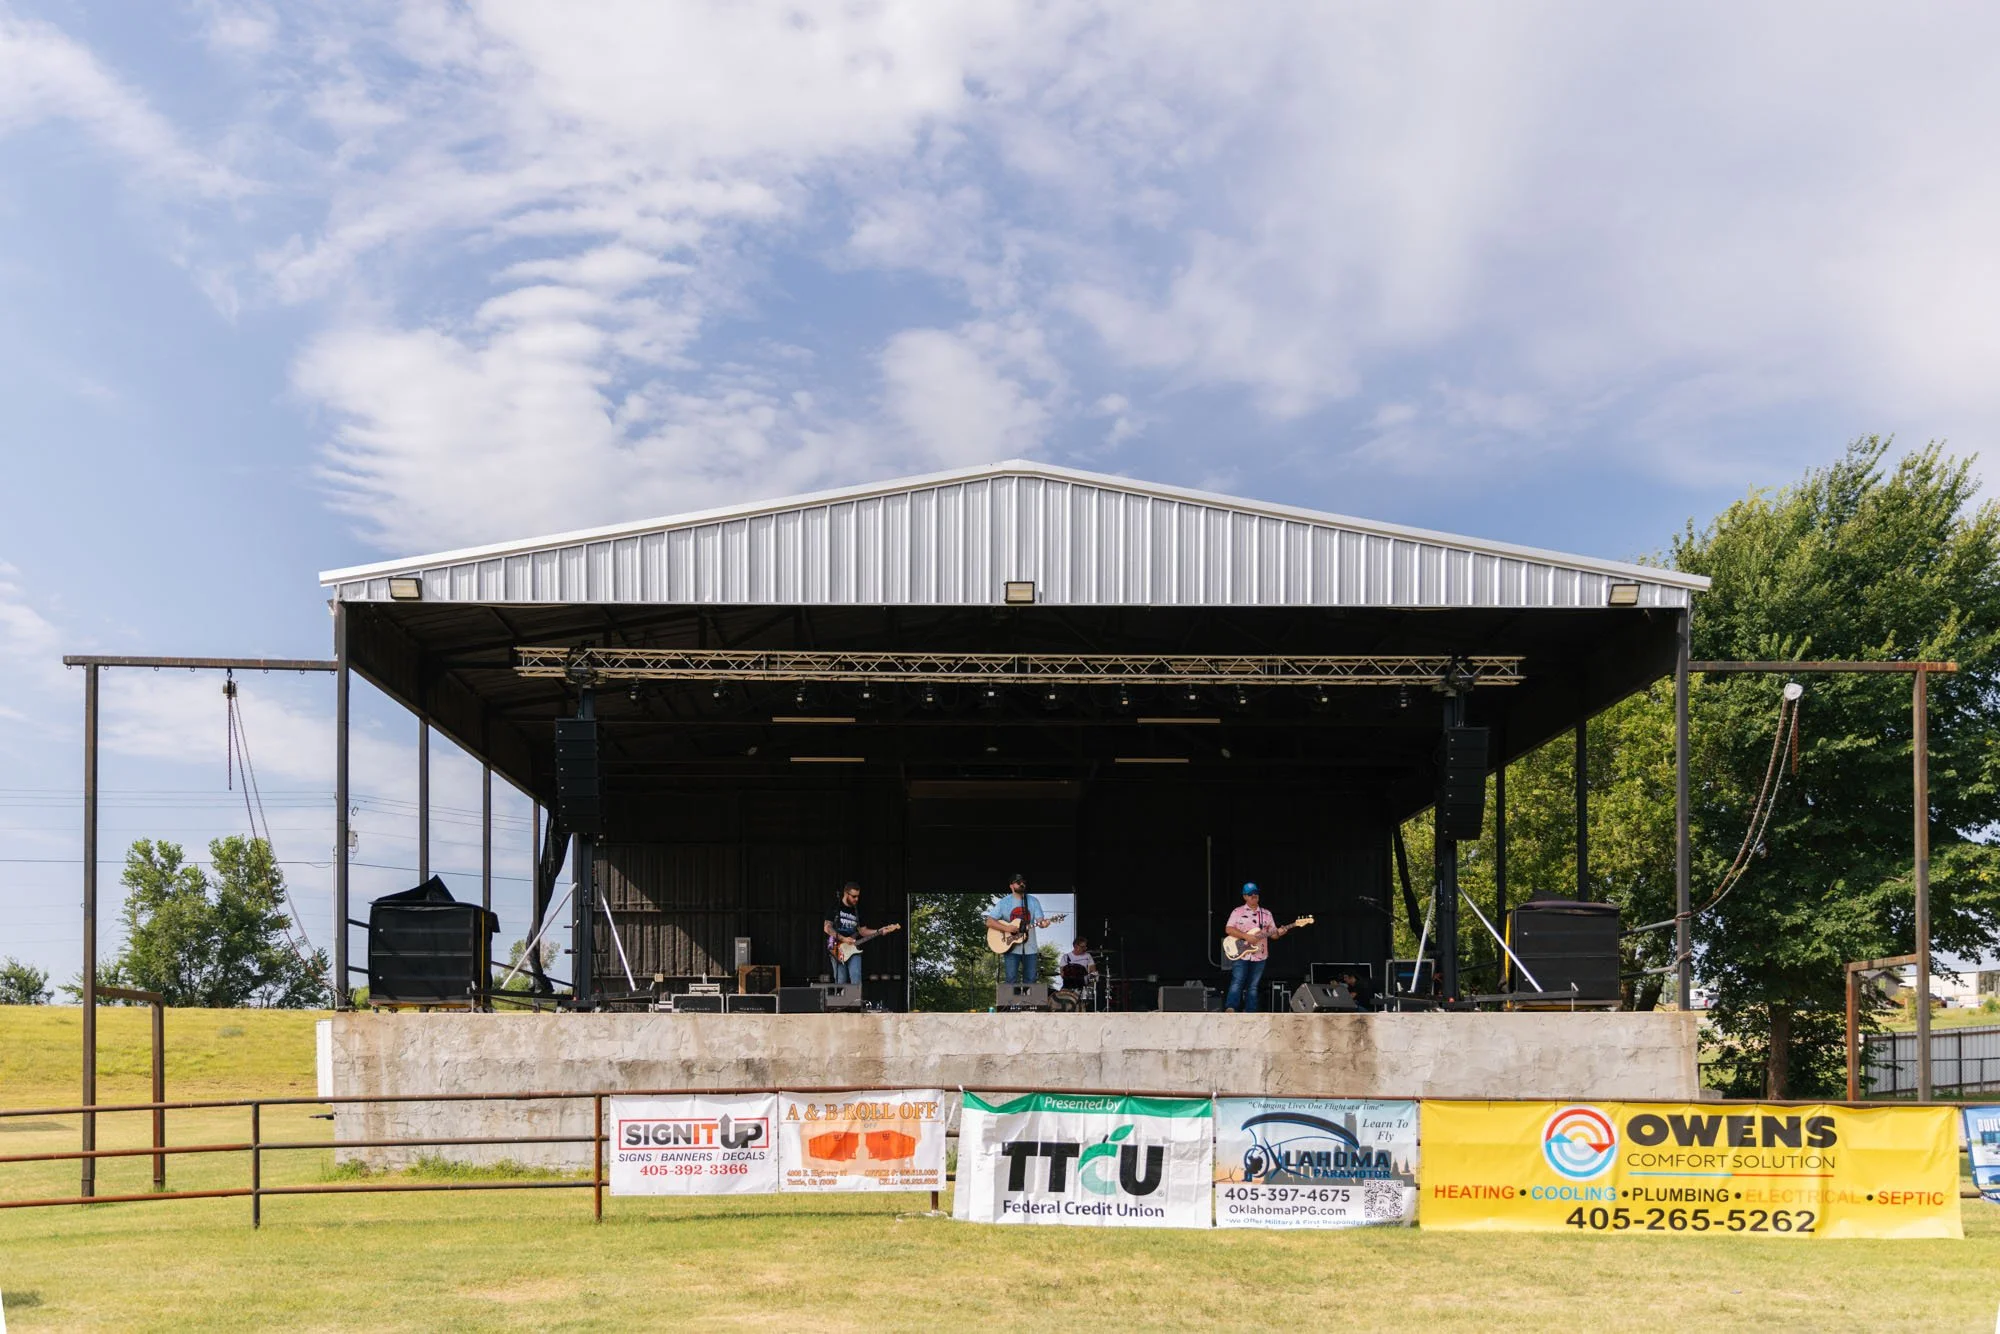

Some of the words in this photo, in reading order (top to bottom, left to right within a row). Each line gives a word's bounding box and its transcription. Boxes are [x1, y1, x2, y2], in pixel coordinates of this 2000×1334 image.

[786, 1103, 800, 1121] A
[804, 1103, 820, 1121] &
[825, 1103, 838, 1121] B
[843, 1102, 896, 1121] ROLL
[899, 1101, 938, 1120] OFF
[1044, 1096, 1104, 1110] Presented
[1106, 1099, 1121, 1112] by
[1288, 1101, 1306, 1110] Lives
[1308, 1103, 1322, 1111] One
[1324, 1103, 1346, 1111] Flight
[1362, 1118, 1394, 1129] Learn
[1396, 1118, 1409, 1129] To
[1978, 1118, 2000, 1132] BUIL
[1377, 1130, 1394, 1143] Fly
[1626, 1113, 1838, 1149] OWENS
[618, 1152, 652, 1163] SIGNS
[661, 1152, 713, 1163] BANNERS
[722, 1151, 766, 1162] DECALS
[1627, 1153, 1729, 1169] COMFORT
[1732, 1155, 1836, 1169] SOLUTION
[639, 1163, 748, 1176] 405-392-3366
[1001, 1140, 1165, 1196] TTCU
[1313, 1168, 1391, 1179] PARAMOTOR
[1224, 1187, 1351, 1202] 405-397-4675
[1434, 1185, 1515, 1199] HEATING
[1531, 1185, 1617, 1201] COOLING
[1632, 1187, 1730, 1202] PLUMBING
[1745, 1189, 1861, 1205] ELECTRICAL
[1878, 1190, 1944, 1206] SEPTIC
[1003, 1200, 1060, 1214] Federal
[1064, 1201, 1113, 1216] Credit
[1116, 1203, 1165, 1217] Union
[1229, 1204, 1347, 1216] OklahomaPPG.com
[1265, 1218, 1293, 1226] Military
[1565, 1206, 1816, 1233] 405-265-5262
